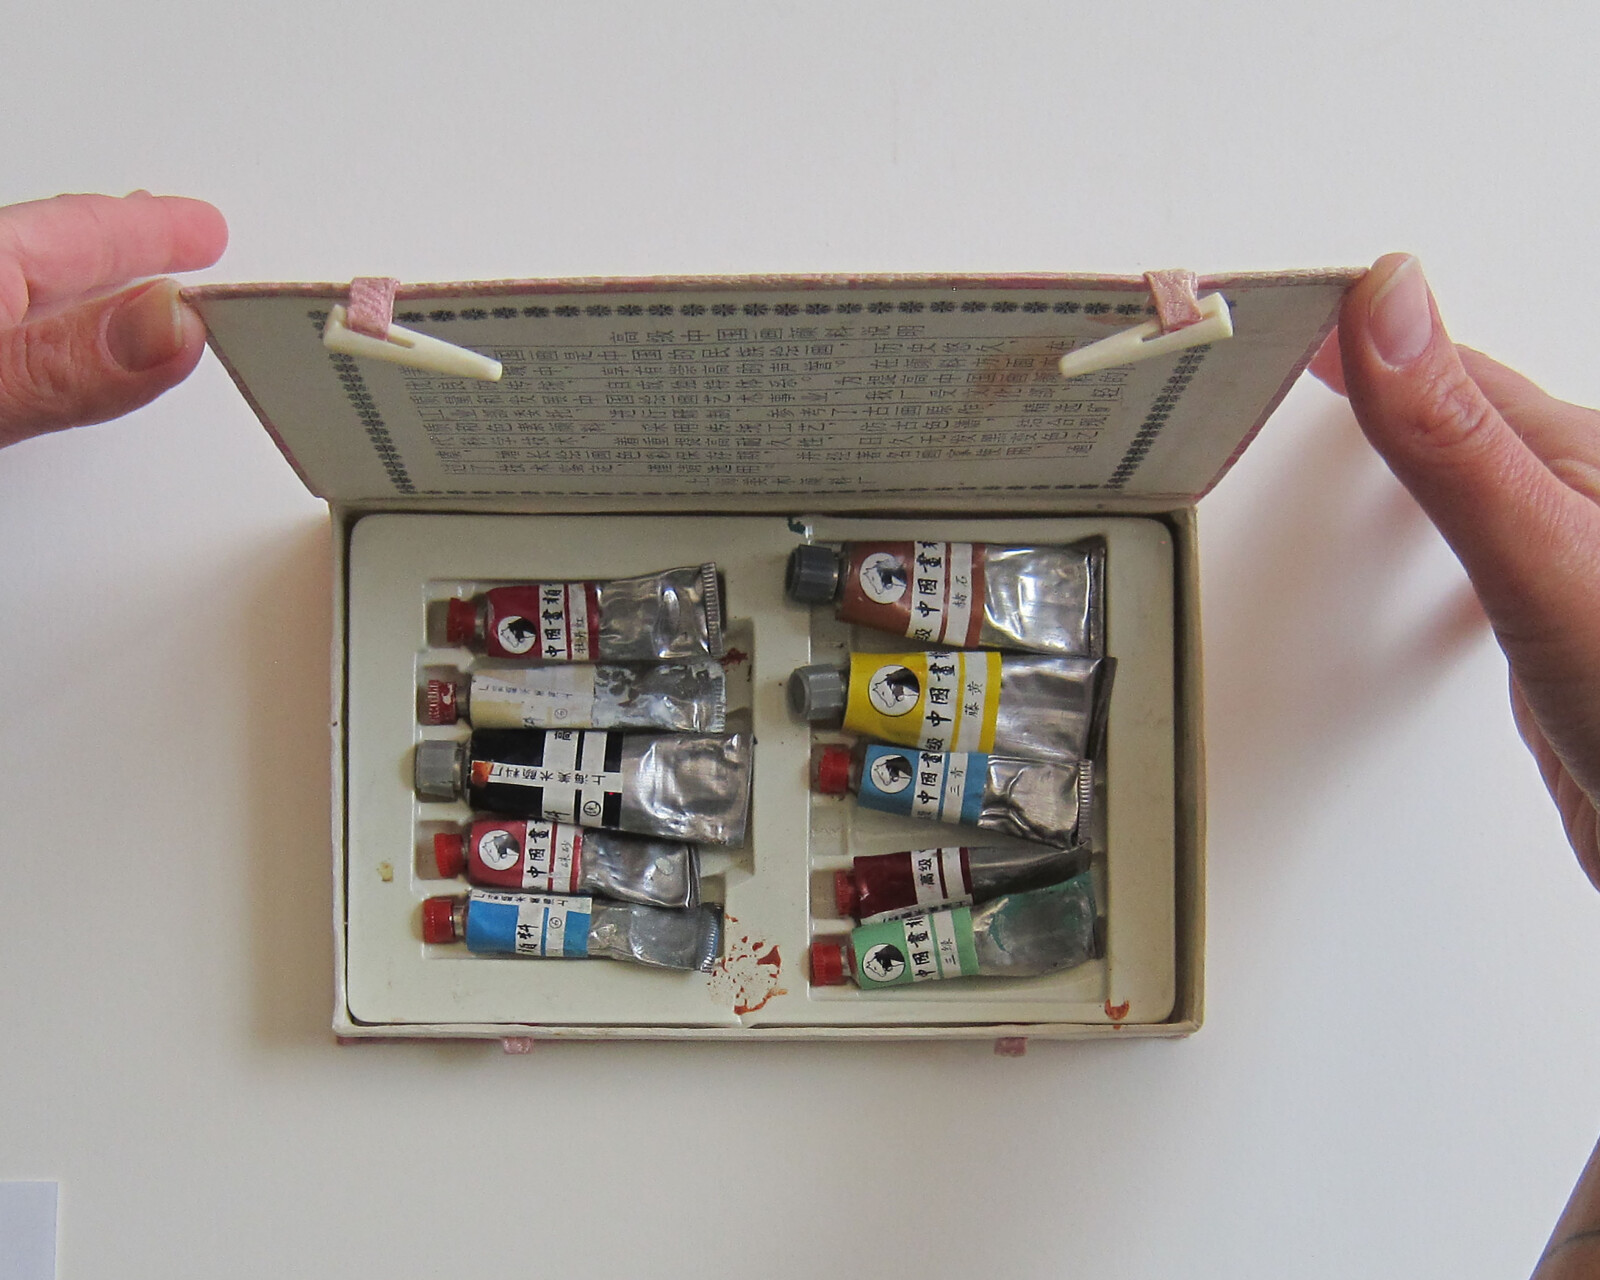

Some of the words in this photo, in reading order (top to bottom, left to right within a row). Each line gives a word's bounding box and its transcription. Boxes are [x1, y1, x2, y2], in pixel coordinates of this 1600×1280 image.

[609, 324, 927, 343] 高级中国画颜料说明
[964, 681, 983, 717] 藤黄
[490, 767, 606, 785] 上海美术颜料厂
[918, 850, 935, 885] 高级
